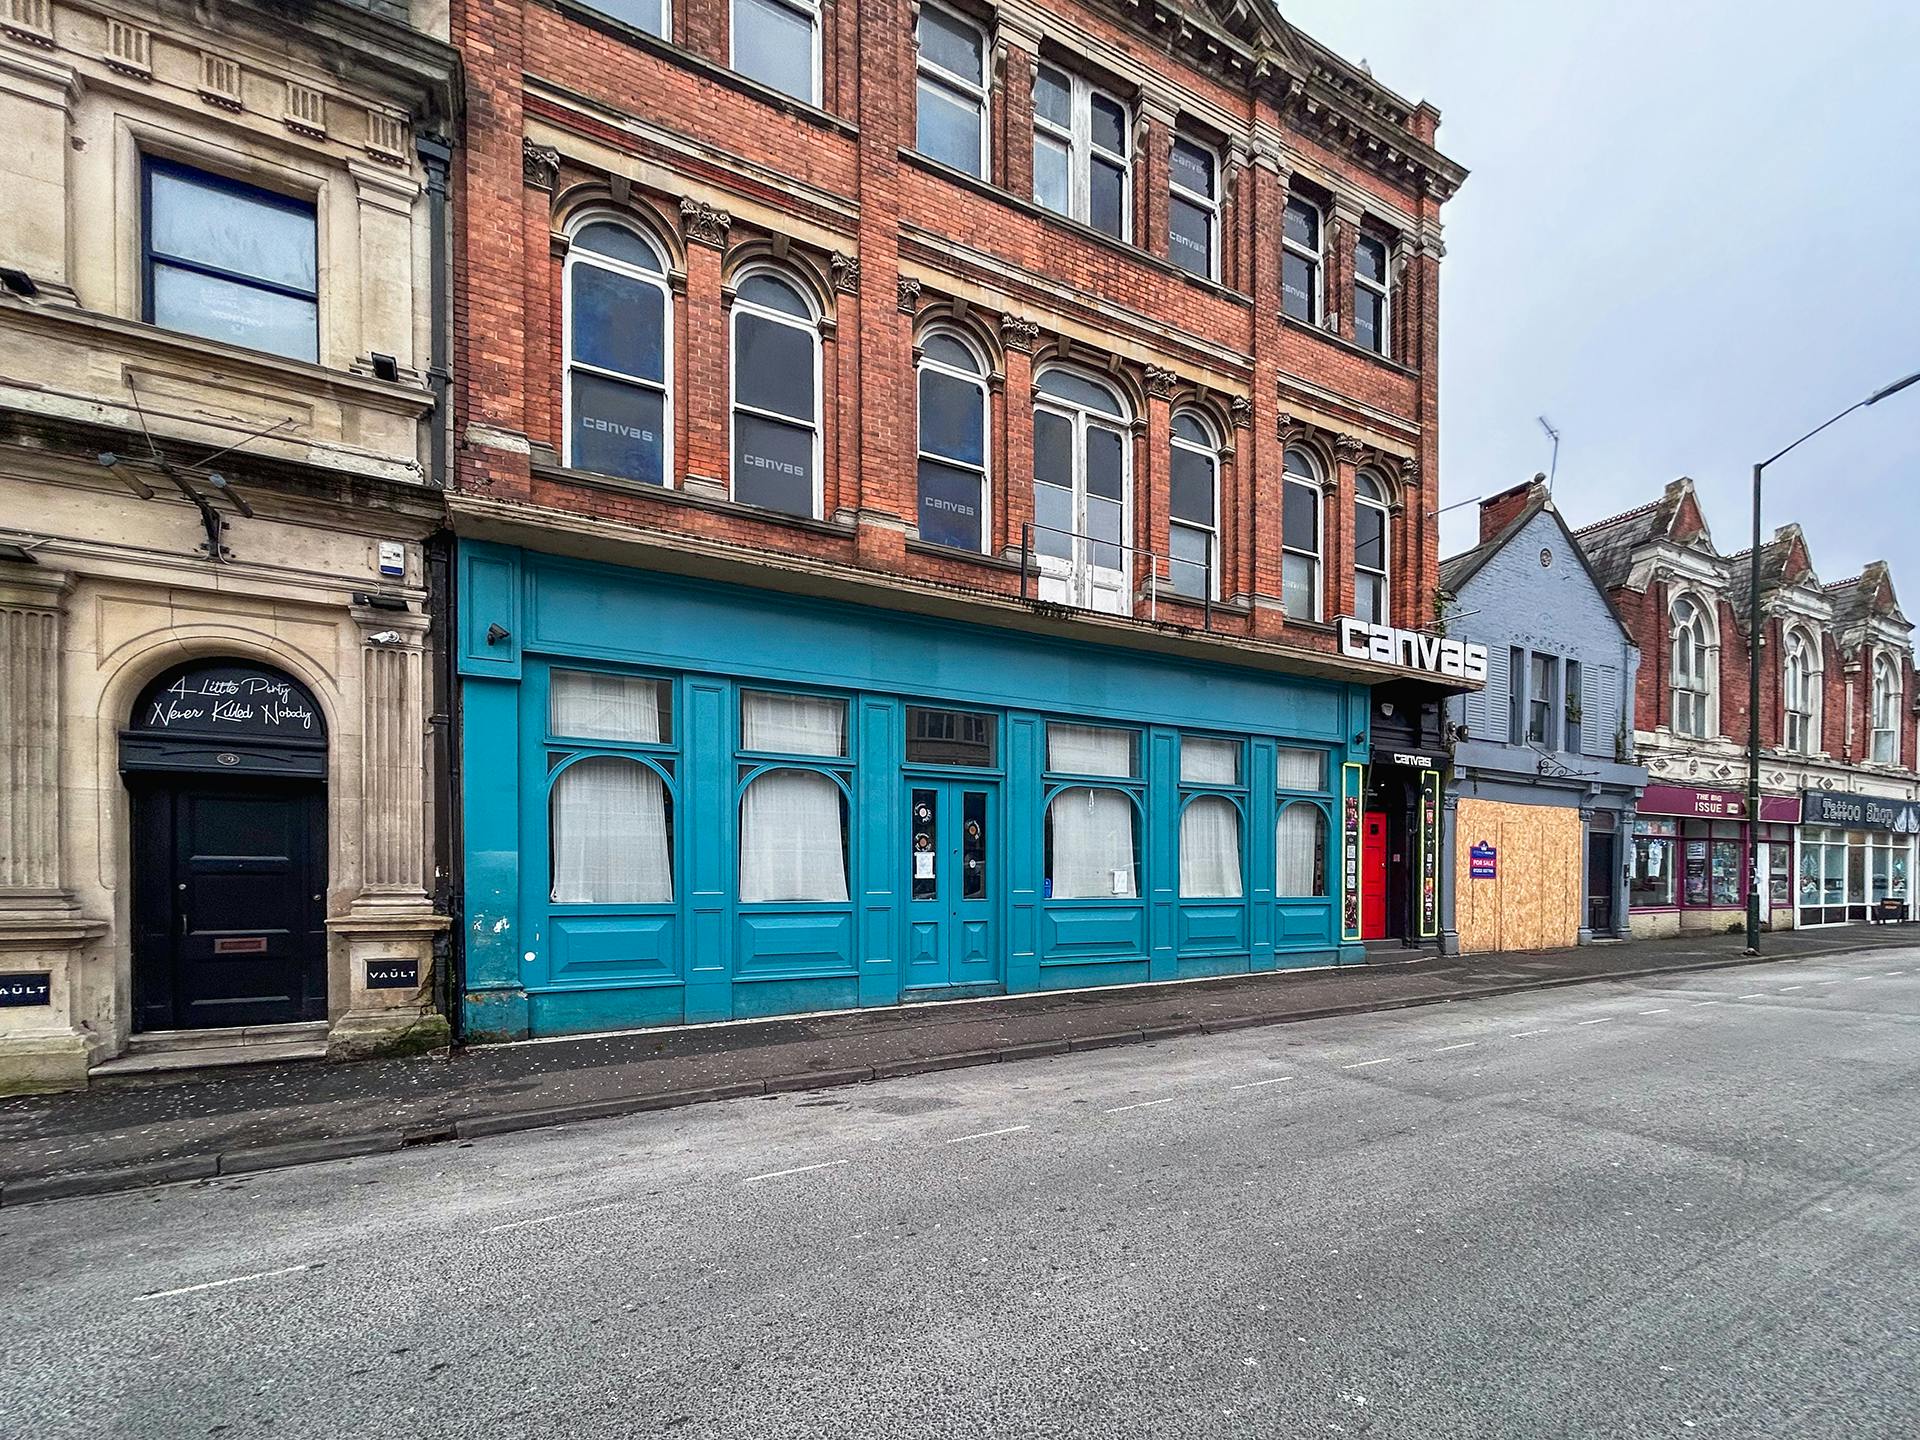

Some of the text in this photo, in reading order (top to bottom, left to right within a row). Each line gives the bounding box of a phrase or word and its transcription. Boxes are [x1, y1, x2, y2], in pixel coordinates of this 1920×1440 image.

[583, 416, 653, 442] canvas
[744, 454, 804, 477] canvas
[925, 496, 975, 516] canvas
[1341, 617, 1488, 681] canvas
[168, 676, 291, 704] A Little Party
[151, 699, 312, 729] Never Killed Nobody
[1393, 753, 1432, 767] canvas
[1695, 802, 1722, 813] ISSUE
[1696, 793, 1709, 801] THE
[1822, 798, 1893, 828] Tattoo Shop
